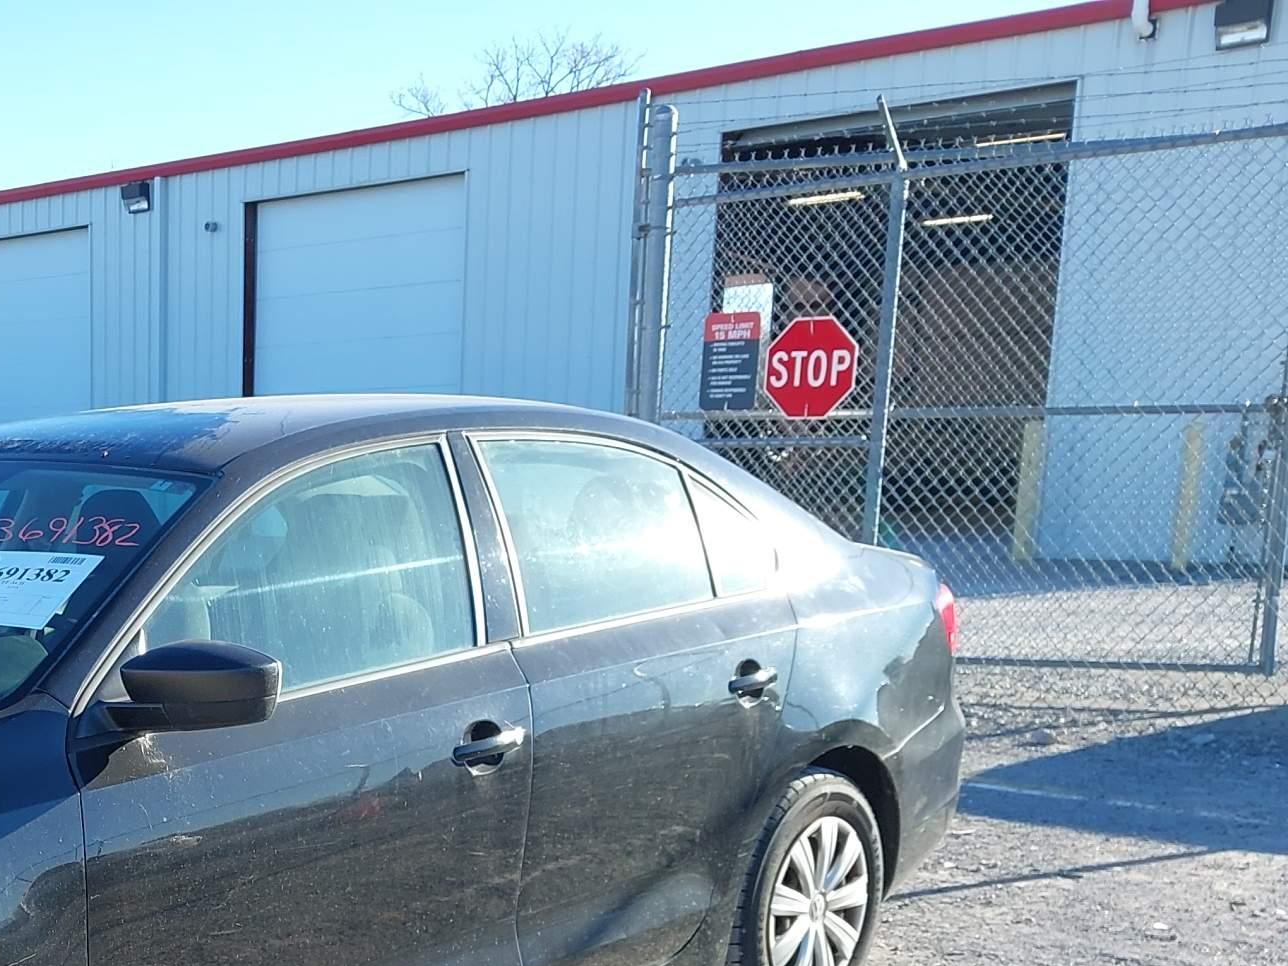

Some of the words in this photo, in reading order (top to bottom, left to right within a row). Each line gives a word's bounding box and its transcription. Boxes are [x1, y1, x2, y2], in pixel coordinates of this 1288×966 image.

[715, 331, 726, 340] 15
[727, 329, 751, 340] MPH
[769, 349, 851, 388] STOP
